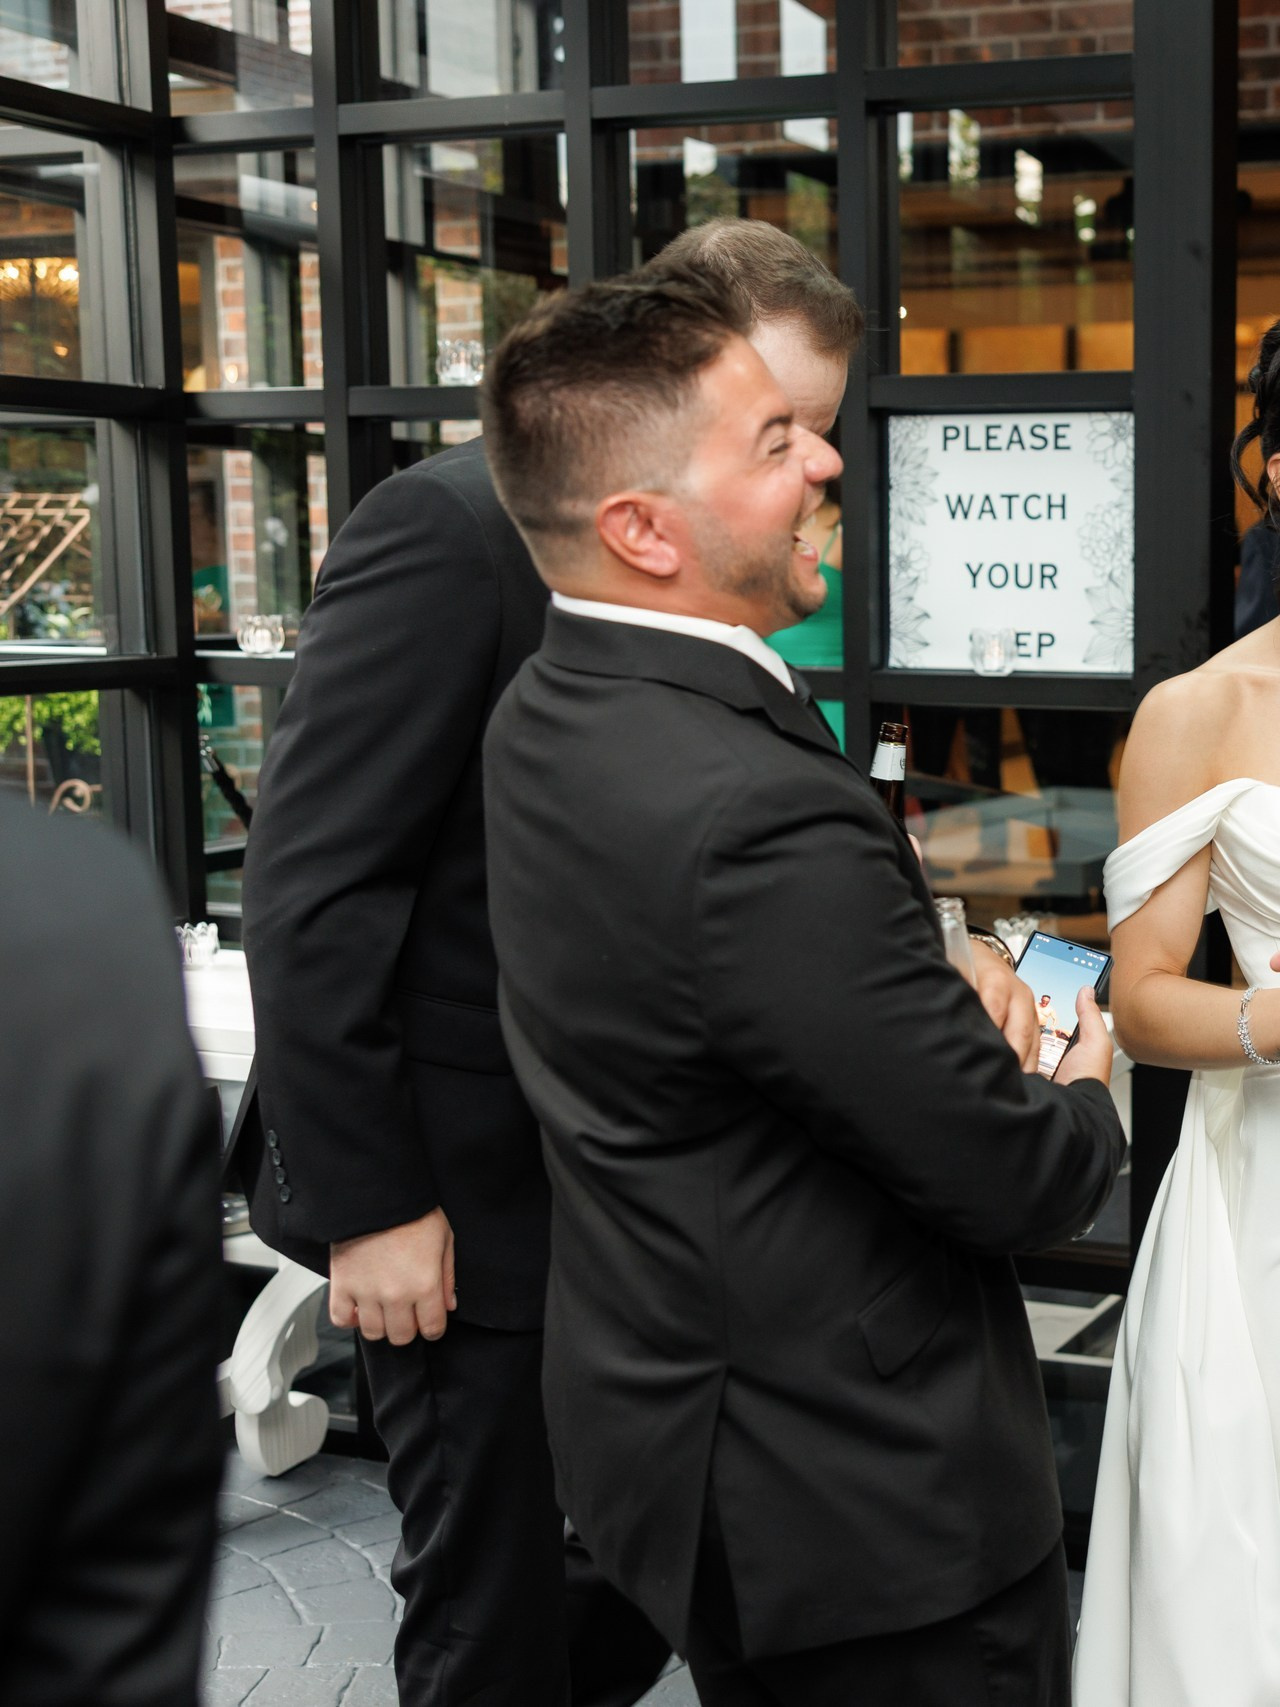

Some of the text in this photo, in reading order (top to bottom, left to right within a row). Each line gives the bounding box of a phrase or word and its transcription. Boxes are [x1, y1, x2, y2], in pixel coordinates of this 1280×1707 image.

[943, 424, 1071, 451] PLEASE
[945, 494, 1067, 520] WATCH
[966, 563, 1059, 589] YOUR
[969, 632, 1055, 658] EP
